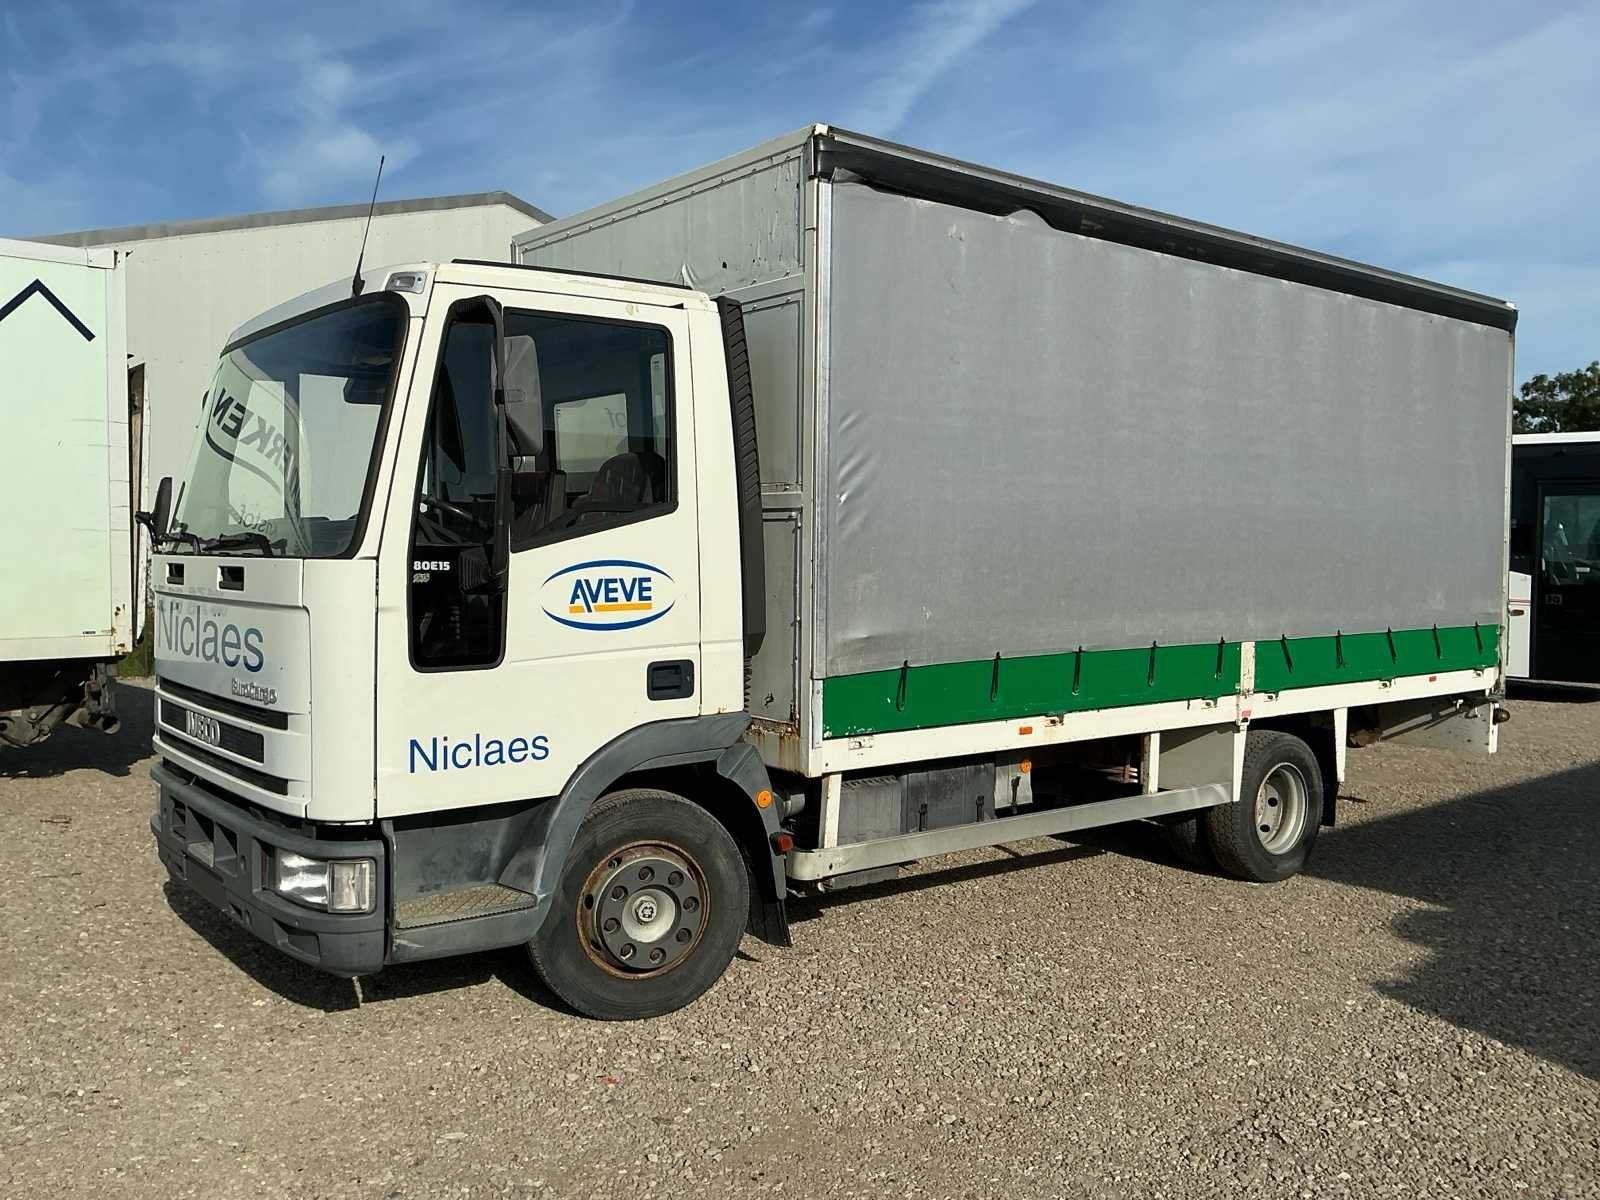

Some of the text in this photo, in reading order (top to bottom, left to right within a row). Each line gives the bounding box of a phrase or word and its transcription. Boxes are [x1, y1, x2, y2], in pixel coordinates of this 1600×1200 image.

[413, 560, 451, 571] 80E15
[569, 577, 653, 613] AVEVE
[157, 599, 265, 673] Niclaes
[408, 732, 550, 774] Niclaes
